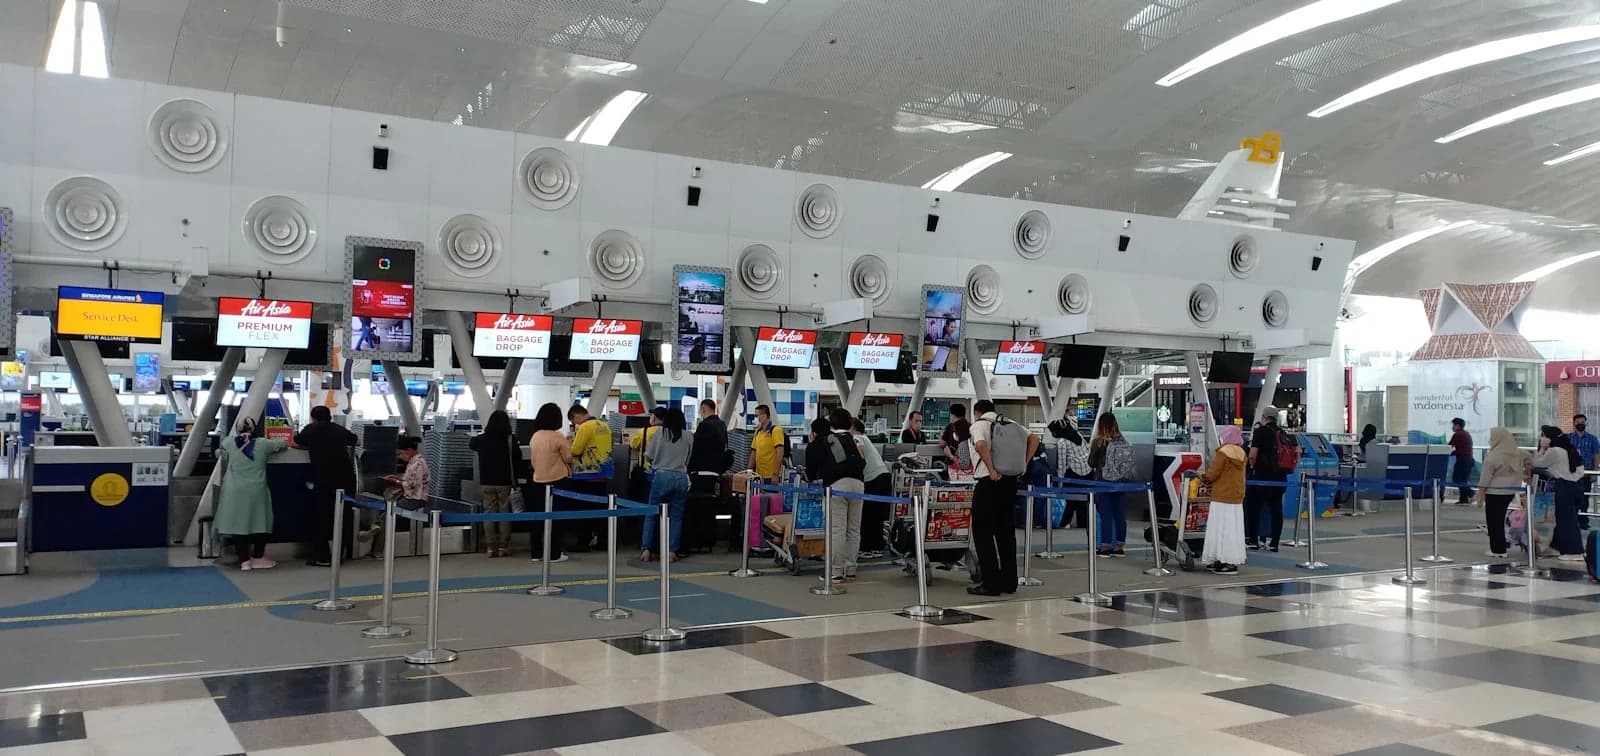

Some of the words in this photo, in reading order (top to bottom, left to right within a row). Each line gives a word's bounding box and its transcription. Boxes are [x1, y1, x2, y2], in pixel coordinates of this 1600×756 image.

[81, 292, 112, 300] SINGAPORE
[241, 299, 292, 317] AirAsia
[81, 311, 114, 322] Service
[493, 313, 535, 330] AirAsia
[237, 321, 293, 333] PREMIUM
[588, 319, 627, 335] AirAsia
[248, 331, 280, 341] FLEX
[496, 335, 543, 344] BAGGAGE
[771, 329, 803, 343] AirAsia
[861, 333, 890, 346] AirAsia
[495, 343, 524, 352] DROP
[591, 338, 633, 347] BAGGAGE
[590, 347, 615, 355] DROP
[771, 346, 807, 356] BAGGAGE
[861, 350, 896, 358] BAGGAGE
[860, 357, 881, 365] DROP
[1414, 400, 1465, 410] indonesia
